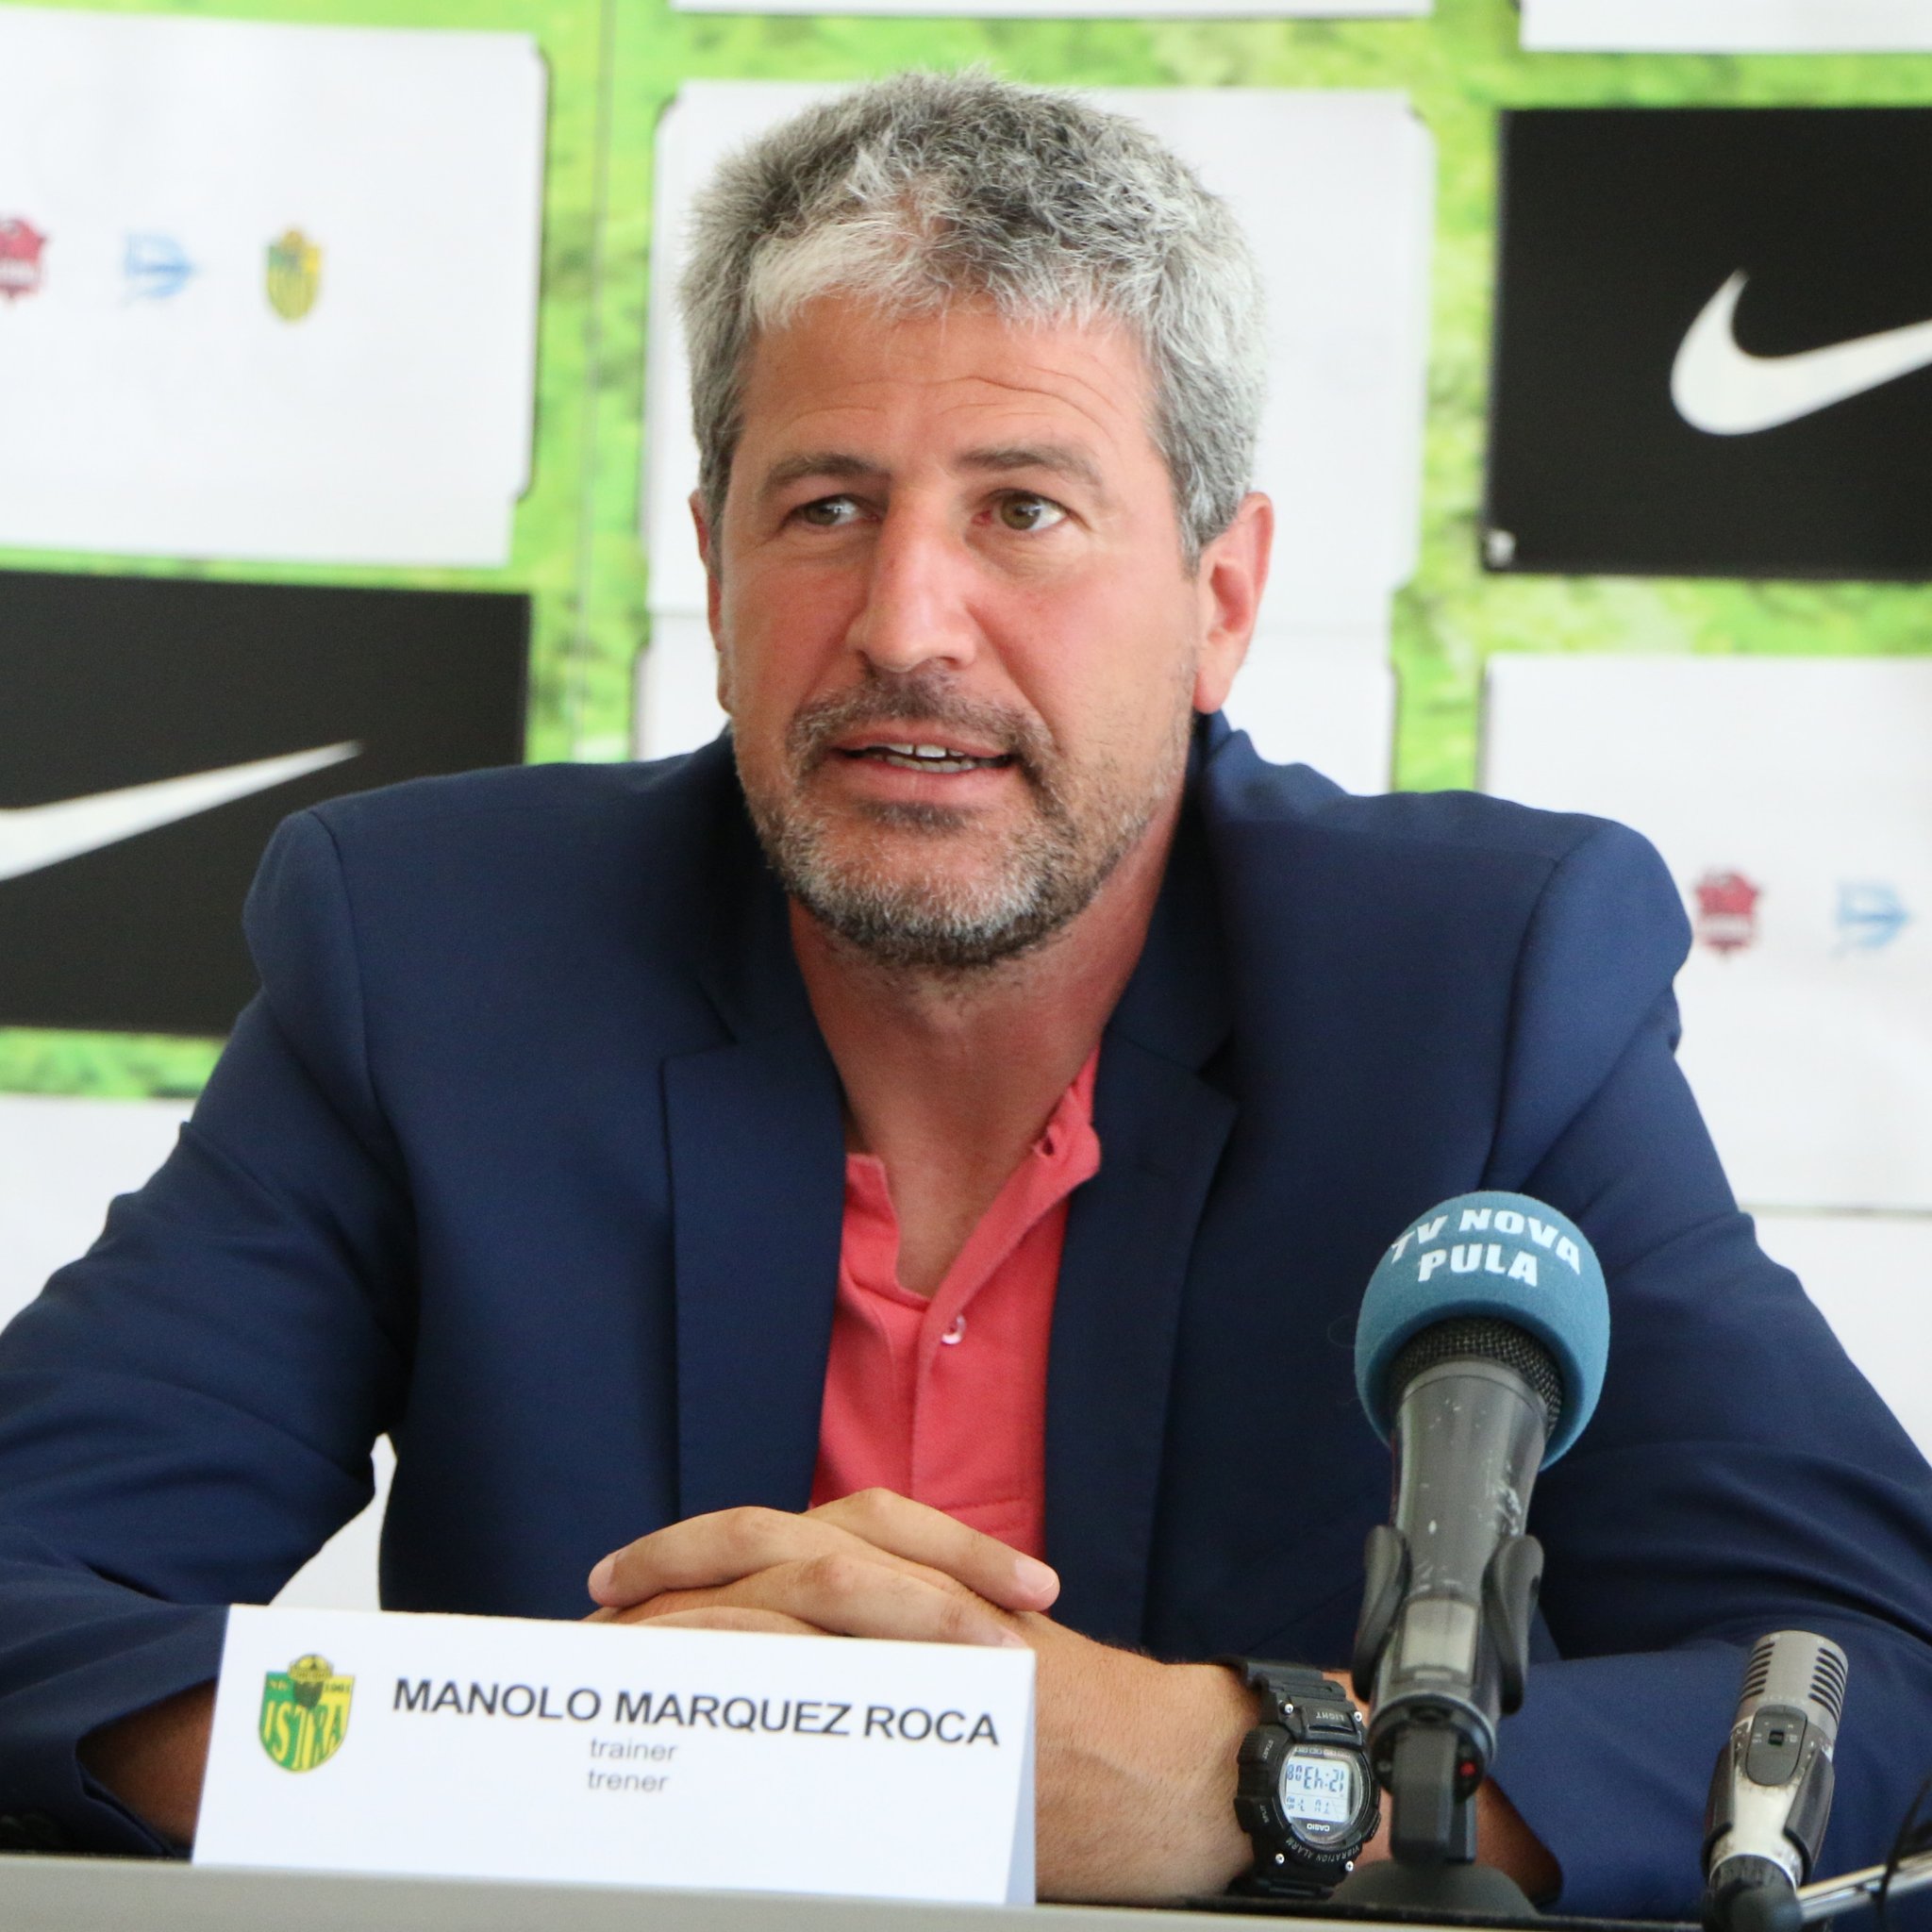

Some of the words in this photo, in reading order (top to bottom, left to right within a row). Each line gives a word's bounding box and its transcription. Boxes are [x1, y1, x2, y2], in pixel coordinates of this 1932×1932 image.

[1391, 1215, 1448, 1264] TV
[1458, 1208, 1581, 1275] NOVA
[1417, 1243, 1539, 1288] PULA
[392, 1678, 602, 1722] MANOLO
[614, 1690, 852, 1736] MARQUEZ
[864, 1706, 1000, 1746] ROCA
[1315, 1711, 1344, 1722] LIGHT
[591, 1738, 678, 1761] trainer
[588, 1770, 671, 1792] trener
[1307, 1823, 1330, 1832] CASIO
[1286, 1838, 1314, 1859] ALARM
[1316, 1844, 1360, 1862] VIBRATION
